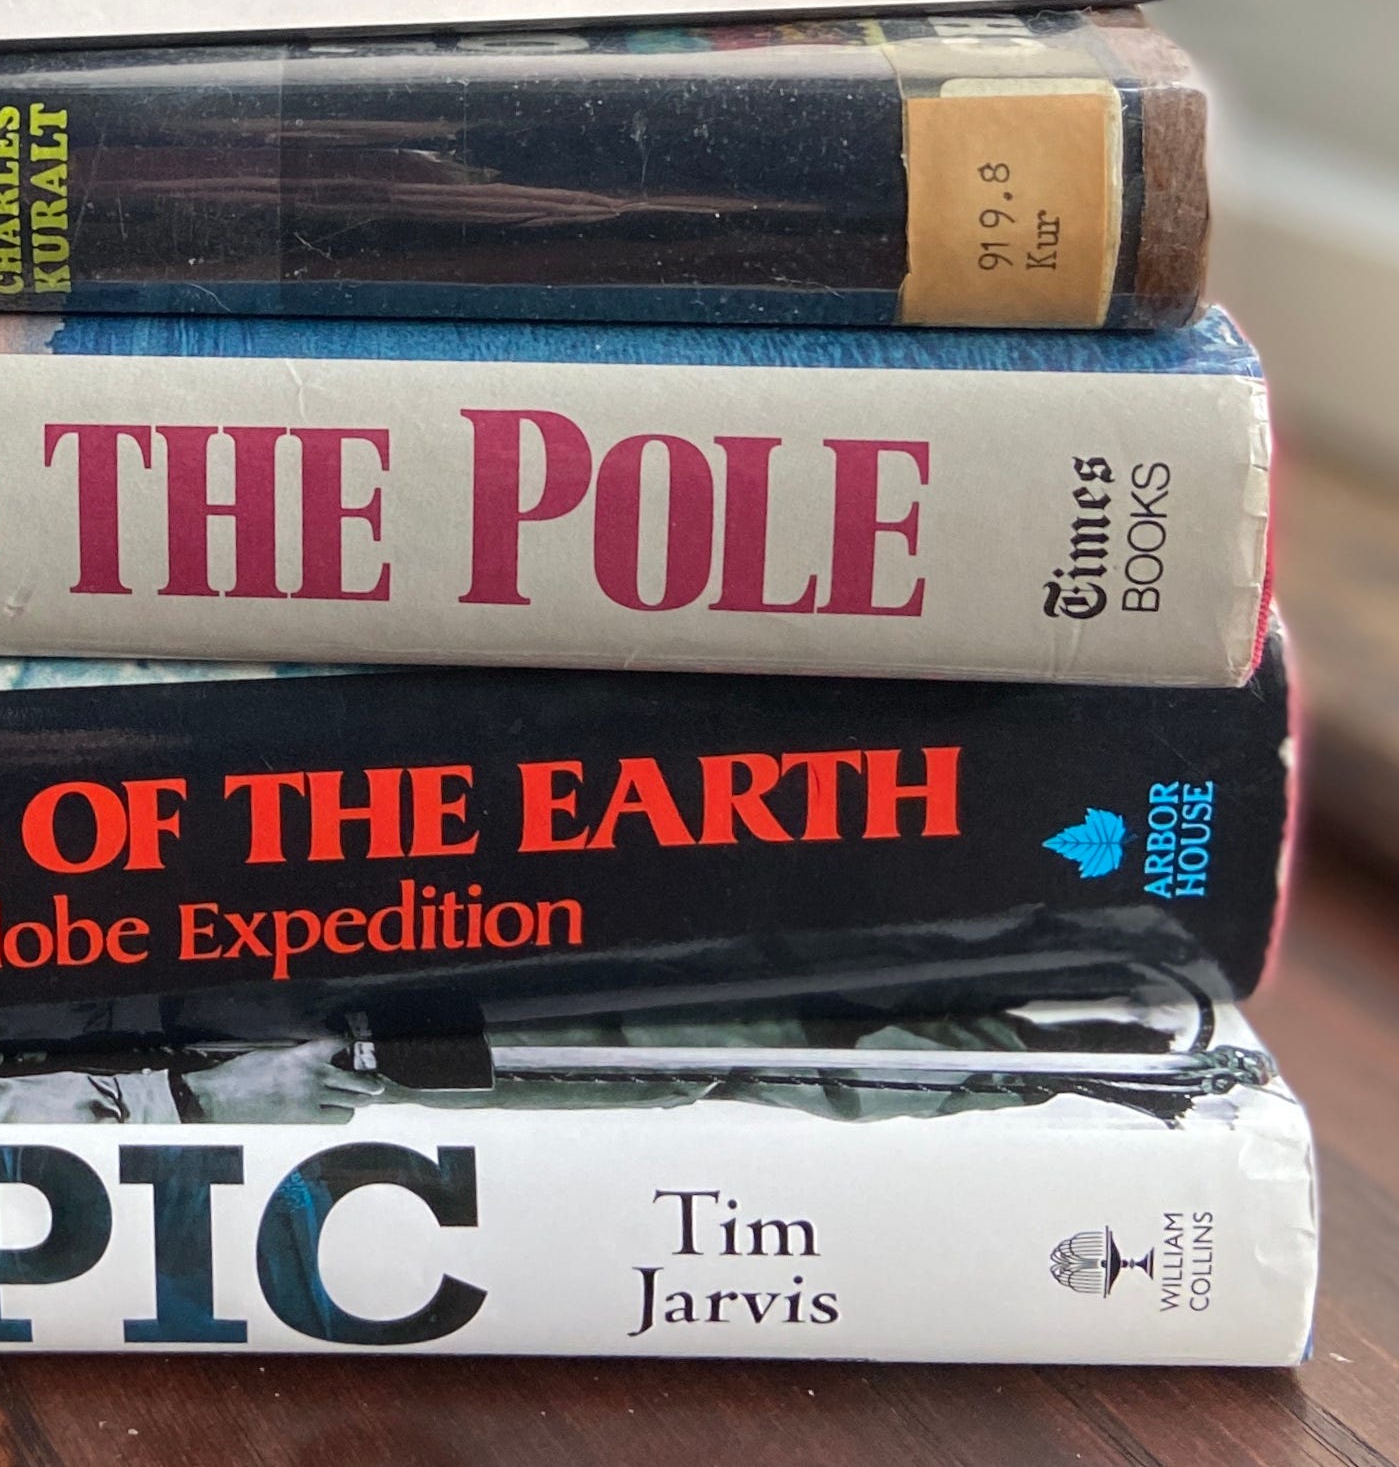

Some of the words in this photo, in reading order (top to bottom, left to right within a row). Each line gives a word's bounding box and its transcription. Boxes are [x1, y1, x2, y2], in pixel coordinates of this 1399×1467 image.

[29, 102, 72, 294] KURALT
[976, 162, 1016, 271] 919.8
[1025, 209, 1061, 271] Kur
[44, 424, 390, 602] THE
[458, 409, 929, 617] POLE
[1043, 457, 1114, 619] Times
[1122, 463, 1170, 612] BOOKS
[22, 778, 186, 873] OF
[224, 765, 479, 863] THE
[517, 747, 961, 852] EARTH
[1143, 780, 1180, 899] ARBOR
[1175, 780, 1214, 897] HOUSE
[179, 877, 582, 980] Expedition
[653, 1190, 820, 1256] Tim
[1159, 1212, 1184, 1312] WILLIAM
[1189, 1211, 1214, 1312] COLLINS
[628, 1268, 838, 1337] Jarvis
